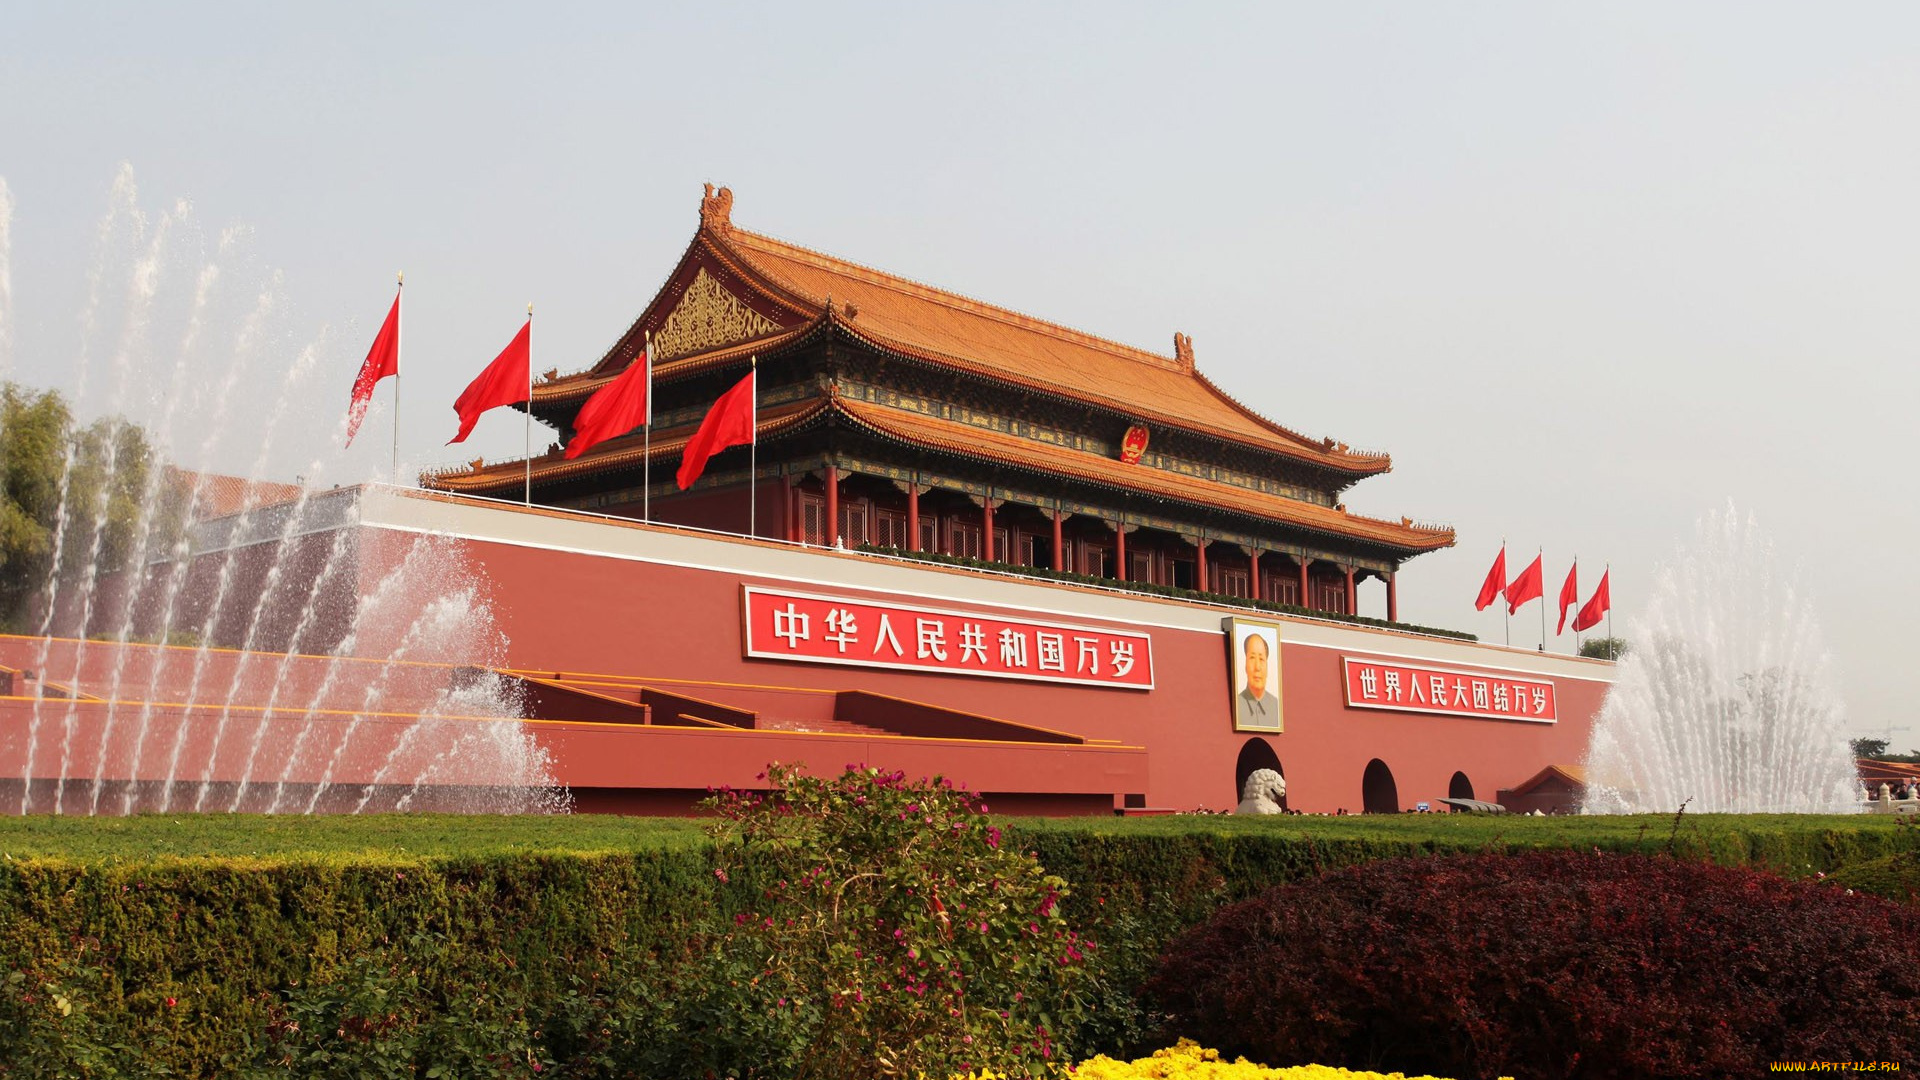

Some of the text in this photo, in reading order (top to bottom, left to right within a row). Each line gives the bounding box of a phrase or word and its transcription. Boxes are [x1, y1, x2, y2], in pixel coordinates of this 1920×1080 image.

[773, 603, 1135, 678] 中华人民共和国万岁
[1360, 668, 1546, 715] 世界人民大团结万岁
